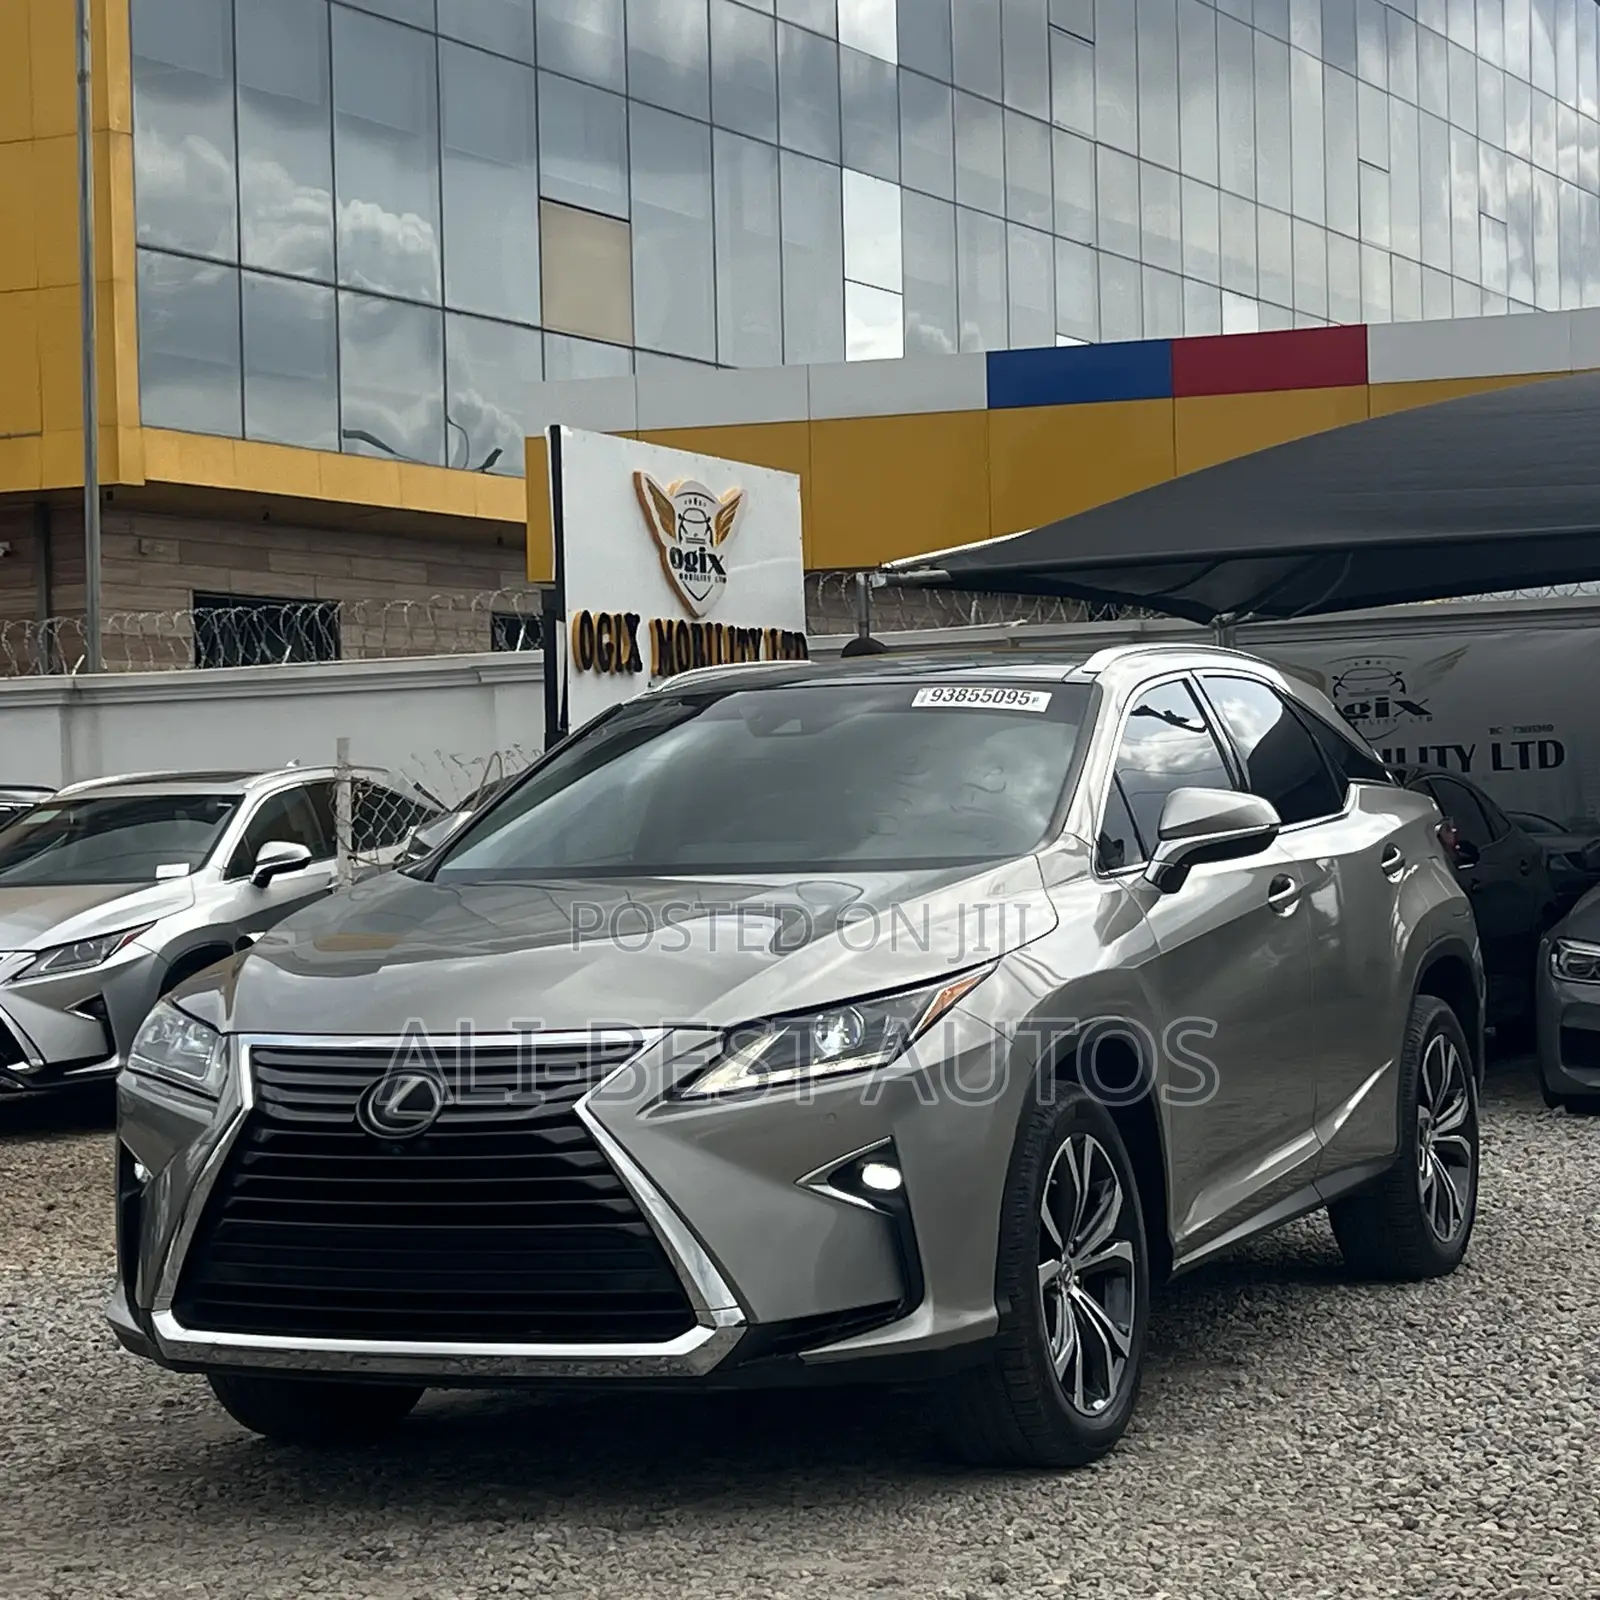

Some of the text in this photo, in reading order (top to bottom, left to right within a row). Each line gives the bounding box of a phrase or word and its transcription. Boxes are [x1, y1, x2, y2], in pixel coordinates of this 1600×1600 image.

[572, 610, 643, 674] OGIX
[929, 687, 1032, 706] 93855095
[1342, 698, 1433, 719] gix
[1490, 739, 1566, 772] LTD
